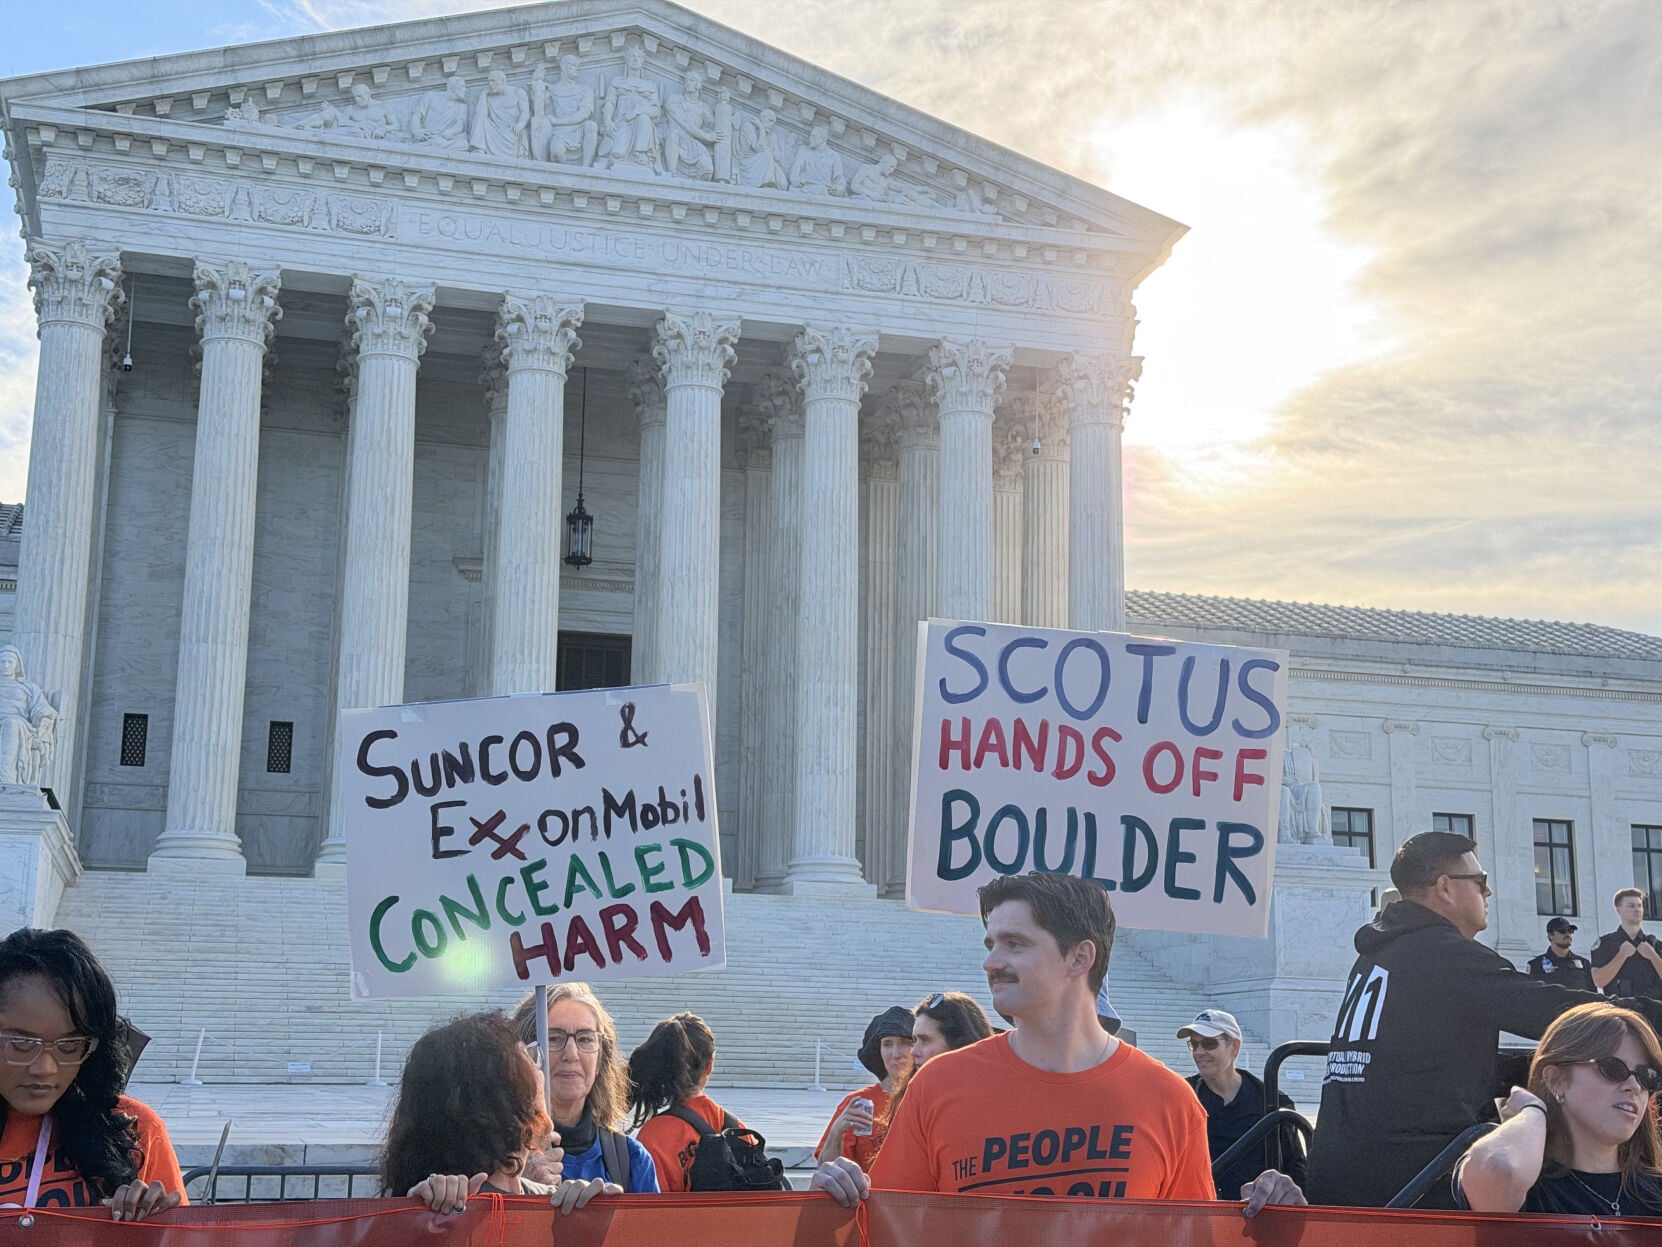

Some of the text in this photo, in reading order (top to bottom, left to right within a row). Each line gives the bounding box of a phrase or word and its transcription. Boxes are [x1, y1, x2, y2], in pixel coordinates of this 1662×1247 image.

[418, 213, 825, 277] EQUAL JUSTICE UNDER LAW
[938, 625, 1281, 739] SCOTUS
[356, 702, 649, 809] SUNCOR &
[938, 716, 1268, 802] HANDS OFF
[936, 788, 1264, 906] BOULDER
[369, 838, 715, 973] CONCEALED
[509, 895, 711, 981] HARM
[952, 1124, 1135, 1182] THE PEOPLE
